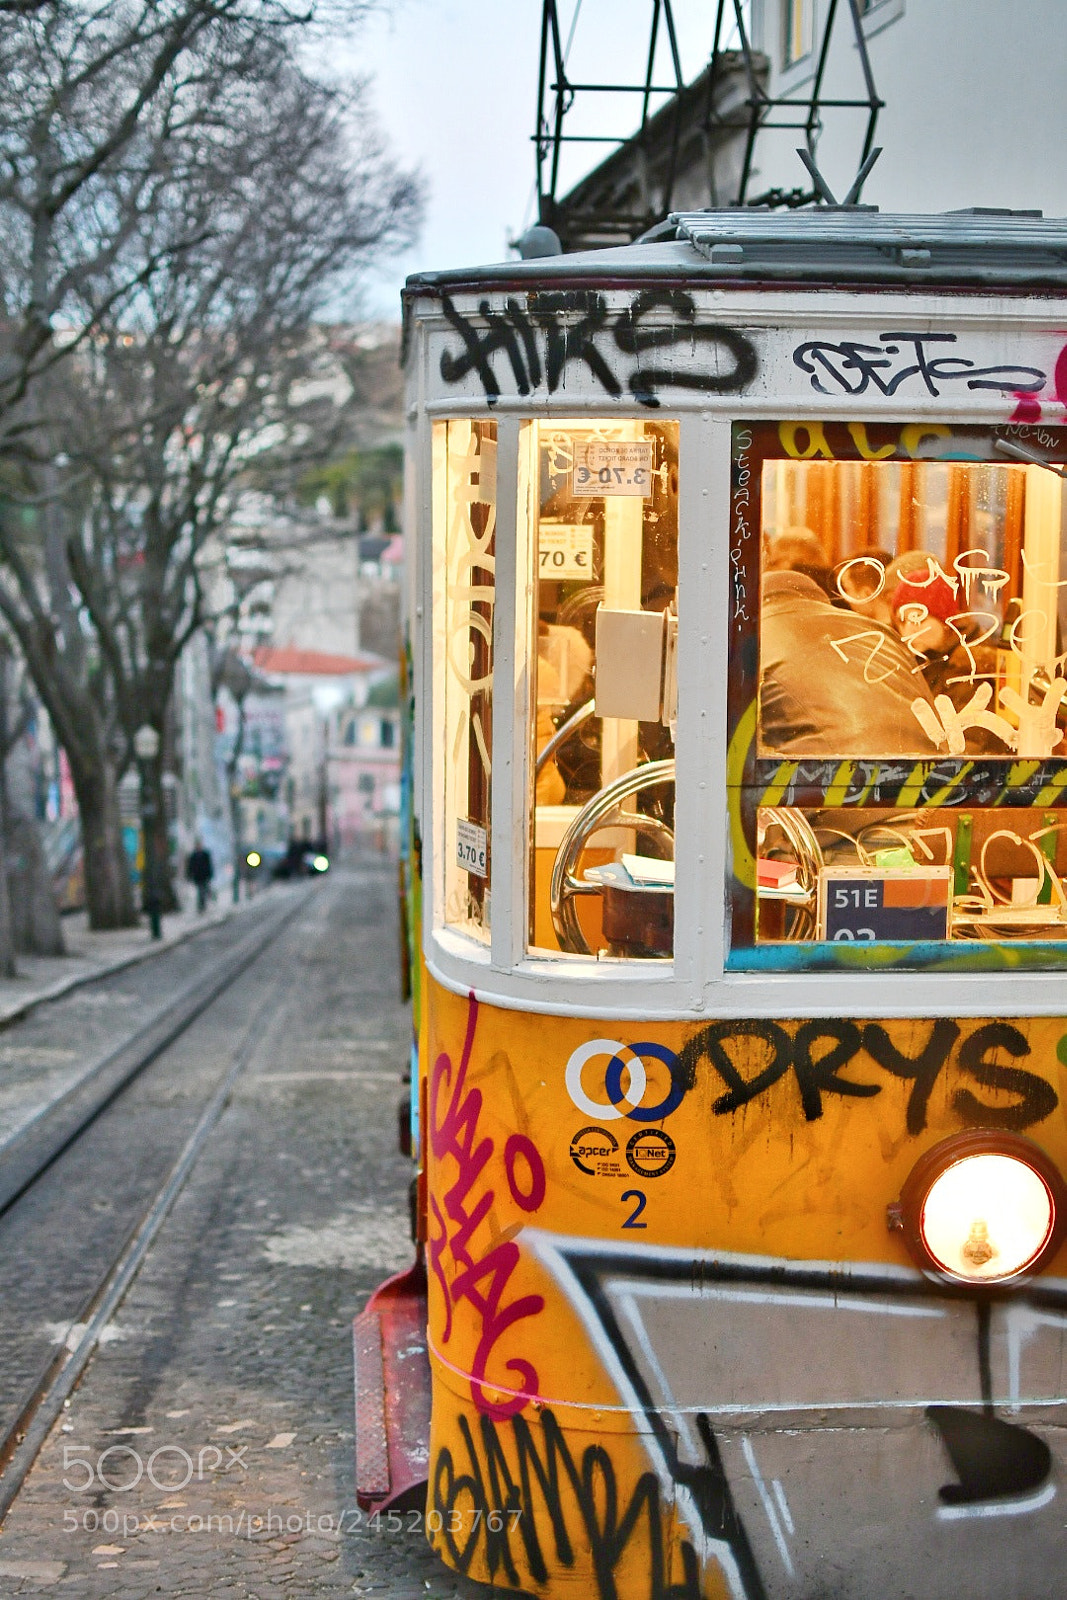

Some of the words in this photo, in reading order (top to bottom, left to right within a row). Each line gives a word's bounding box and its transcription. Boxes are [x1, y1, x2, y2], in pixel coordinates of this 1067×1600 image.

[574, 551, 587, 567] €
[458, 842, 477, 864] 3.70
[479, 851, 485, 868] €
[834, 889, 878, 909] 51E
[578, 1146, 611, 1158] apcer
[620, 1189, 648, 1229] 2
